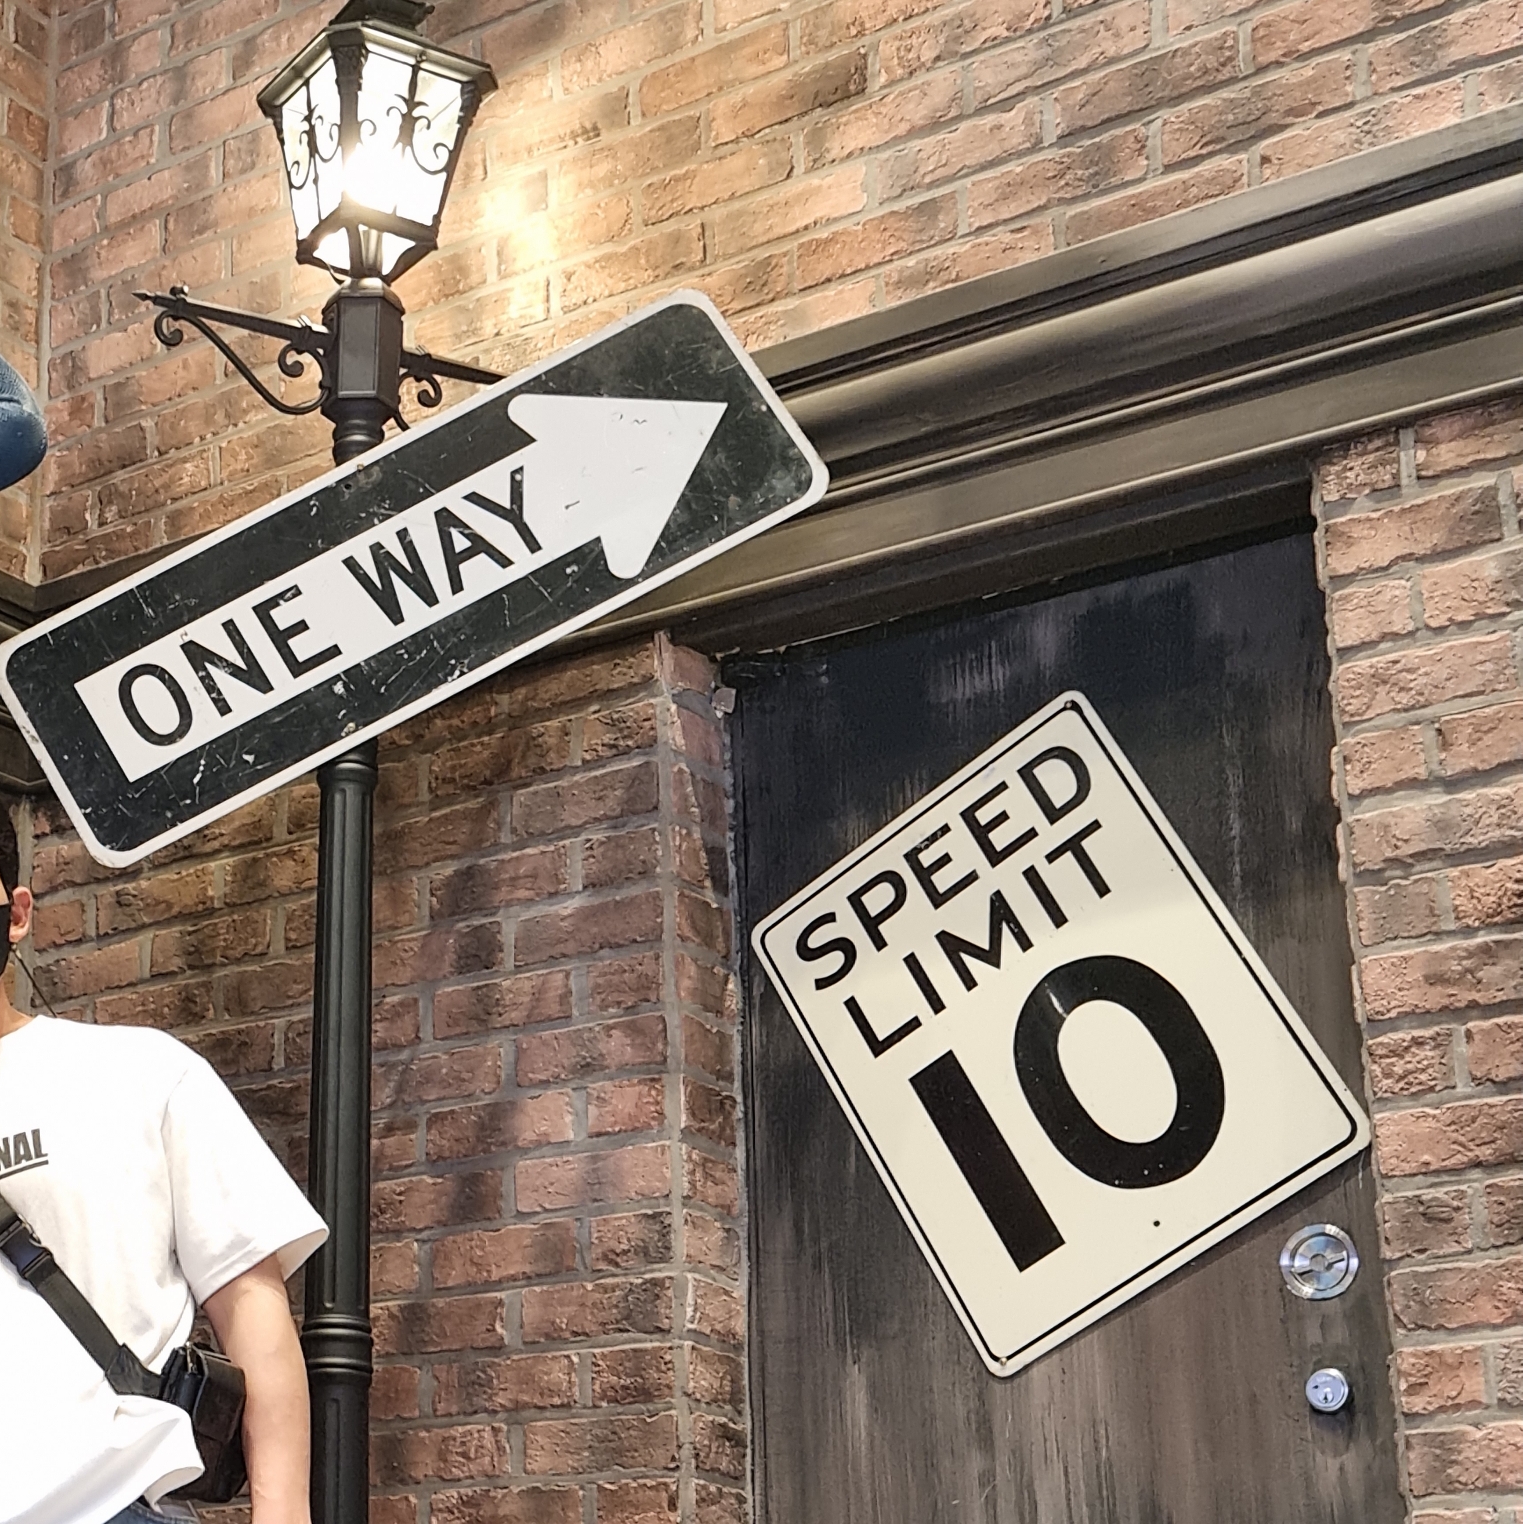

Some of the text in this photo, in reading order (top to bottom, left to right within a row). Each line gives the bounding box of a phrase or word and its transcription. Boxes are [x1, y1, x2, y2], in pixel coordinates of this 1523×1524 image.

[119, 466, 542, 746] ONE WAY
[796, 746, 1090, 990] SPEED
[844, 819, 1111, 1058] LIMIT
[909, 952, 1225, 1272] 10
